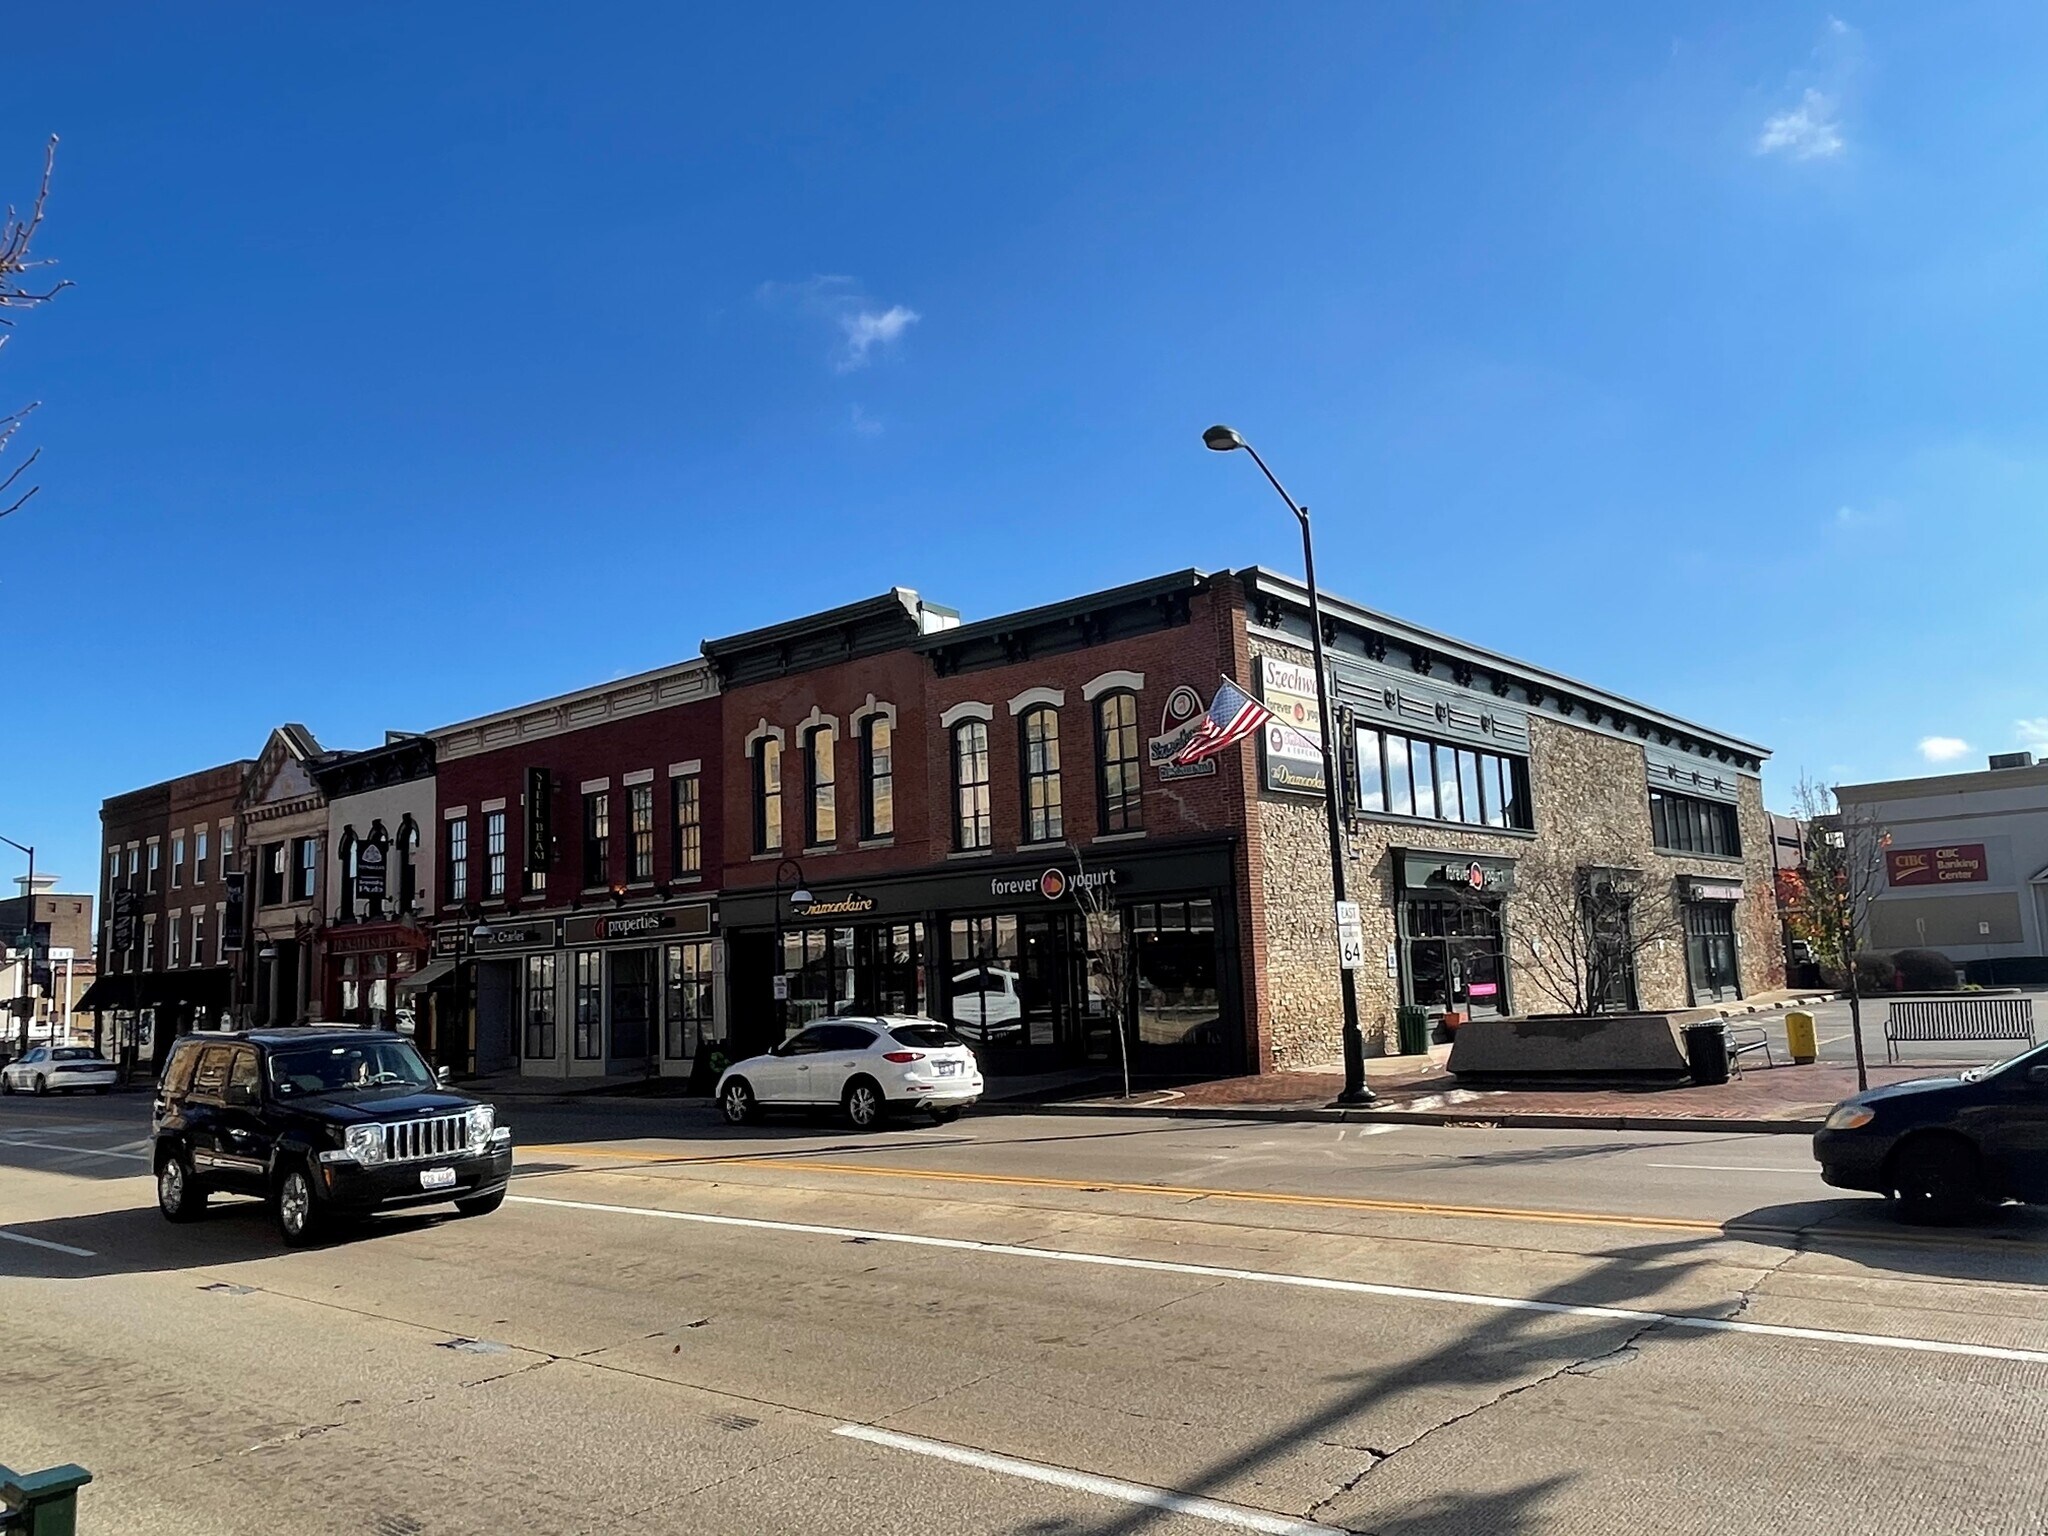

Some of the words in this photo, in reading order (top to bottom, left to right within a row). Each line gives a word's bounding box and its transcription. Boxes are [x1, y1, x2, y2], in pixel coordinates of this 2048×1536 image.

[1936, 848, 1960, 859] CIBC
[1895, 854, 1929, 867] CIBC
[1937, 859, 1979, 870] Banking
[1938, 869, 1973, 881] Center
[991, 878, 1039, 896] forever
[1067, 868, 1117, 892] yogurt
[1341, 907, 1356, 919] EAST
[1344, 942, 1361, 961] 64
